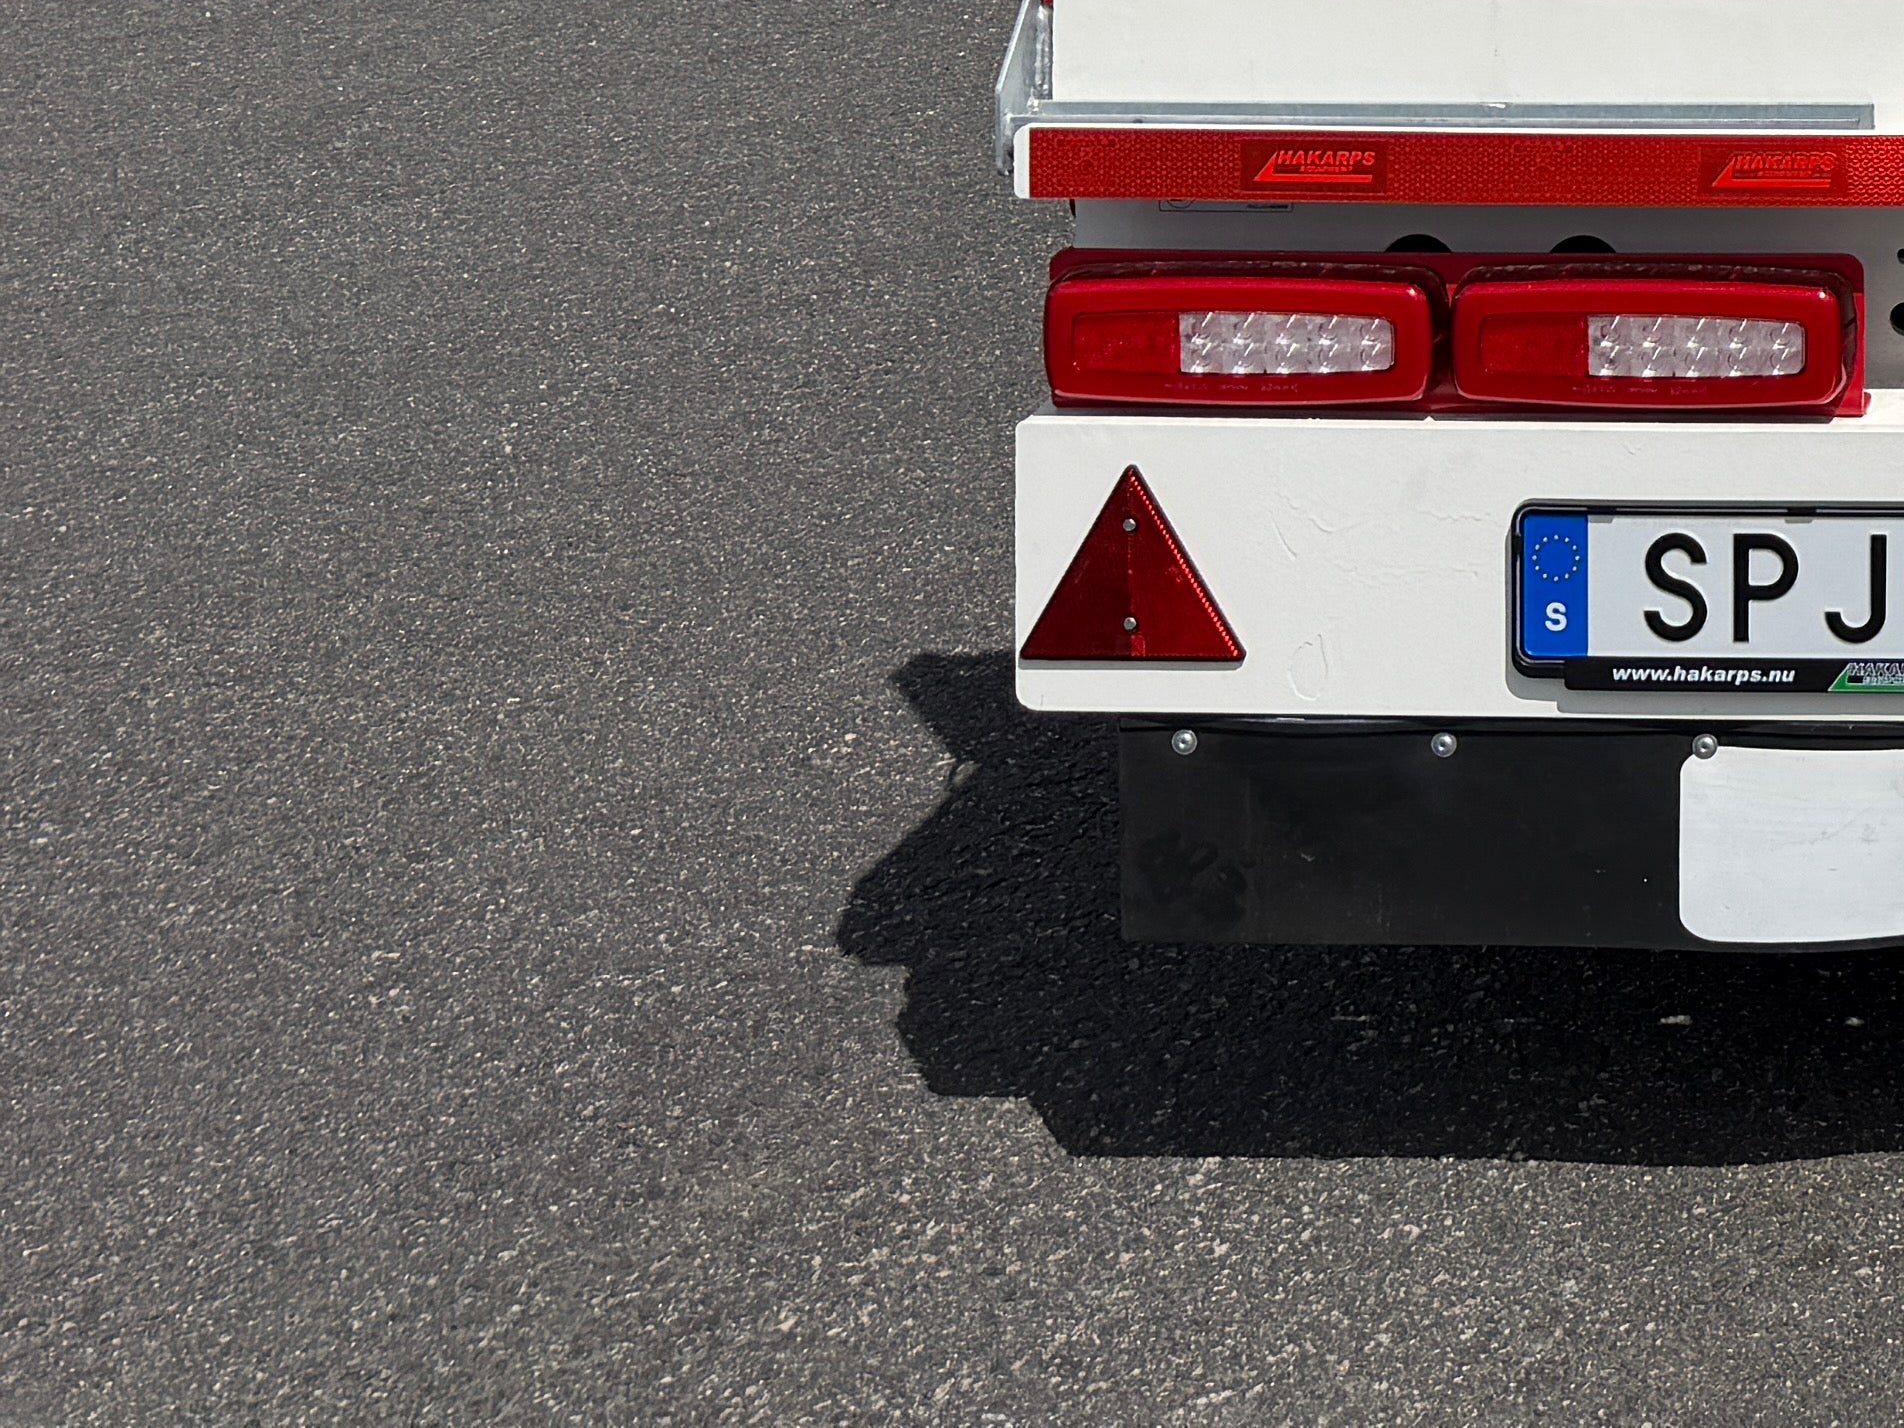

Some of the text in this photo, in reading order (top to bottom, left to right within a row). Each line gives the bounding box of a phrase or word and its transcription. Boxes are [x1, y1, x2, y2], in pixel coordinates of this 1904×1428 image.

[1277, 150, 1376, 166] HAKARPS
[1644, 532, 1887, 644] SPJ
[1544, 602, 1568, 632] S
[1612, 664, 1796, 686] www.hakarps.nu
